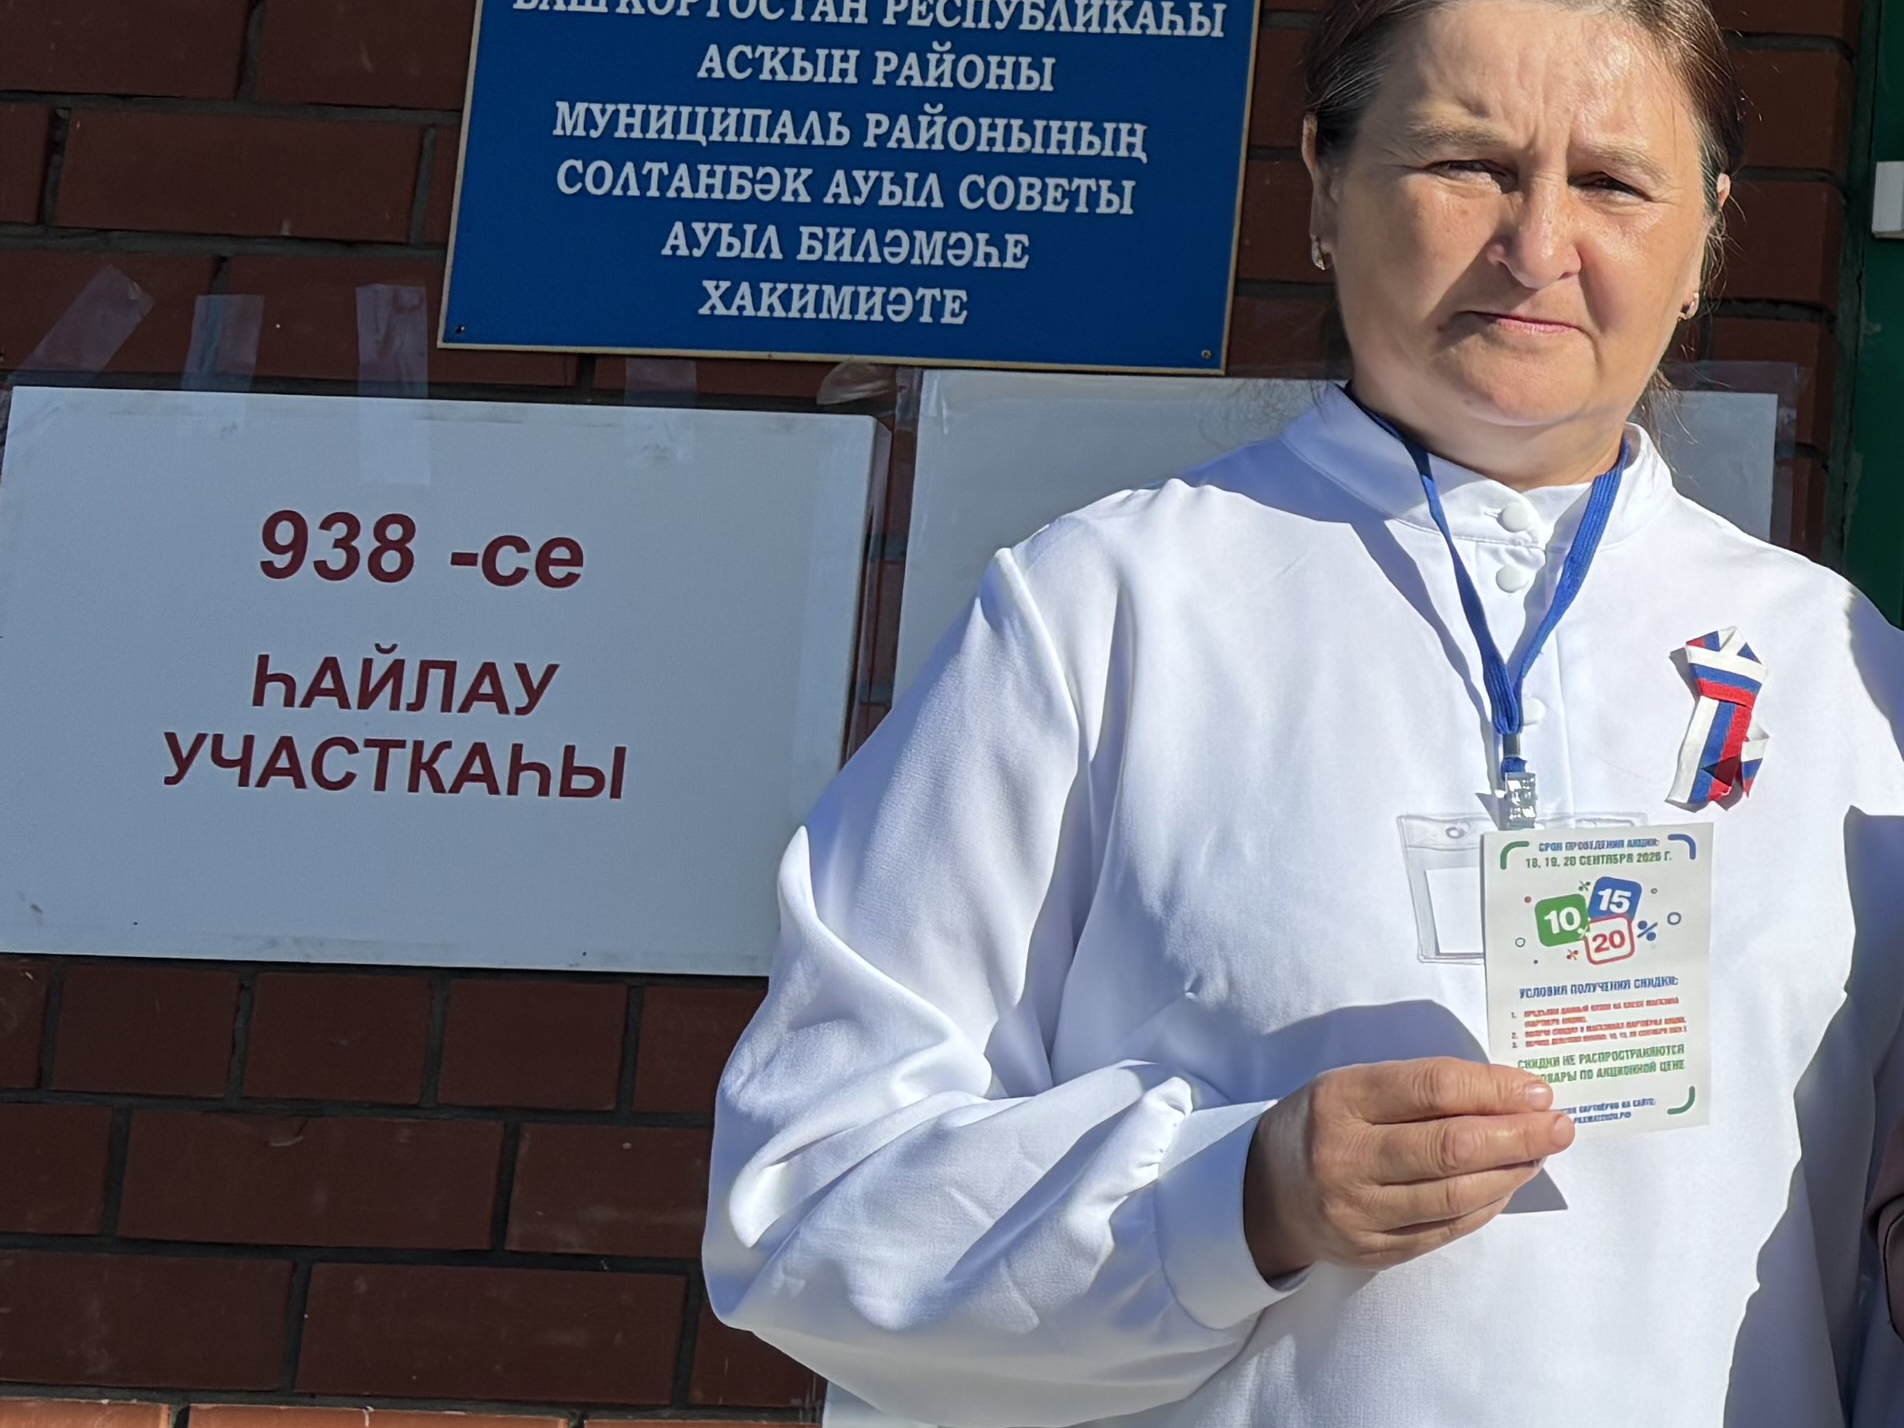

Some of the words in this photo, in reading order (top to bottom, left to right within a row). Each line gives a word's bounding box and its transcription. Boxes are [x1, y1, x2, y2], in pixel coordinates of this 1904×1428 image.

[697, 43, 860, 85] АСҠЫН
[872, 40, 1056, 93] РАЙОНЫ
[552, 100, 851, 148] МУНИЦИПАЛЬ
[863, 103, 1149, 164] РАЙОНЫНЫҢ
[556, 158, 812, 204] СОЛТАНБӘК
[823, 169, 944, 209] АУЫЛ
[958, 174, 1136, 216] СОВЕТЫ
[661, 220, 783, 260] АУЫЛ
[796, 226, 1031, 270] БИЛӘМӘҺЕ
[698, 279, 969, 326] ХАКИМИӘТЕ
[260, 509, 416, 583] 938
[450, 533, 585, 589] -се
[252, 642, 560, 716] ҺАЙЛАУ
[163, 732, 627, 800] УЧАСТКАҺЫ
[1579, 853, 1634, 866] СЕНТЯБРЯ
[1544, 906, 1581, 934] 10
[1597, 888, 1632, 914] 15
[1592, 930, 1626, 953] 20
